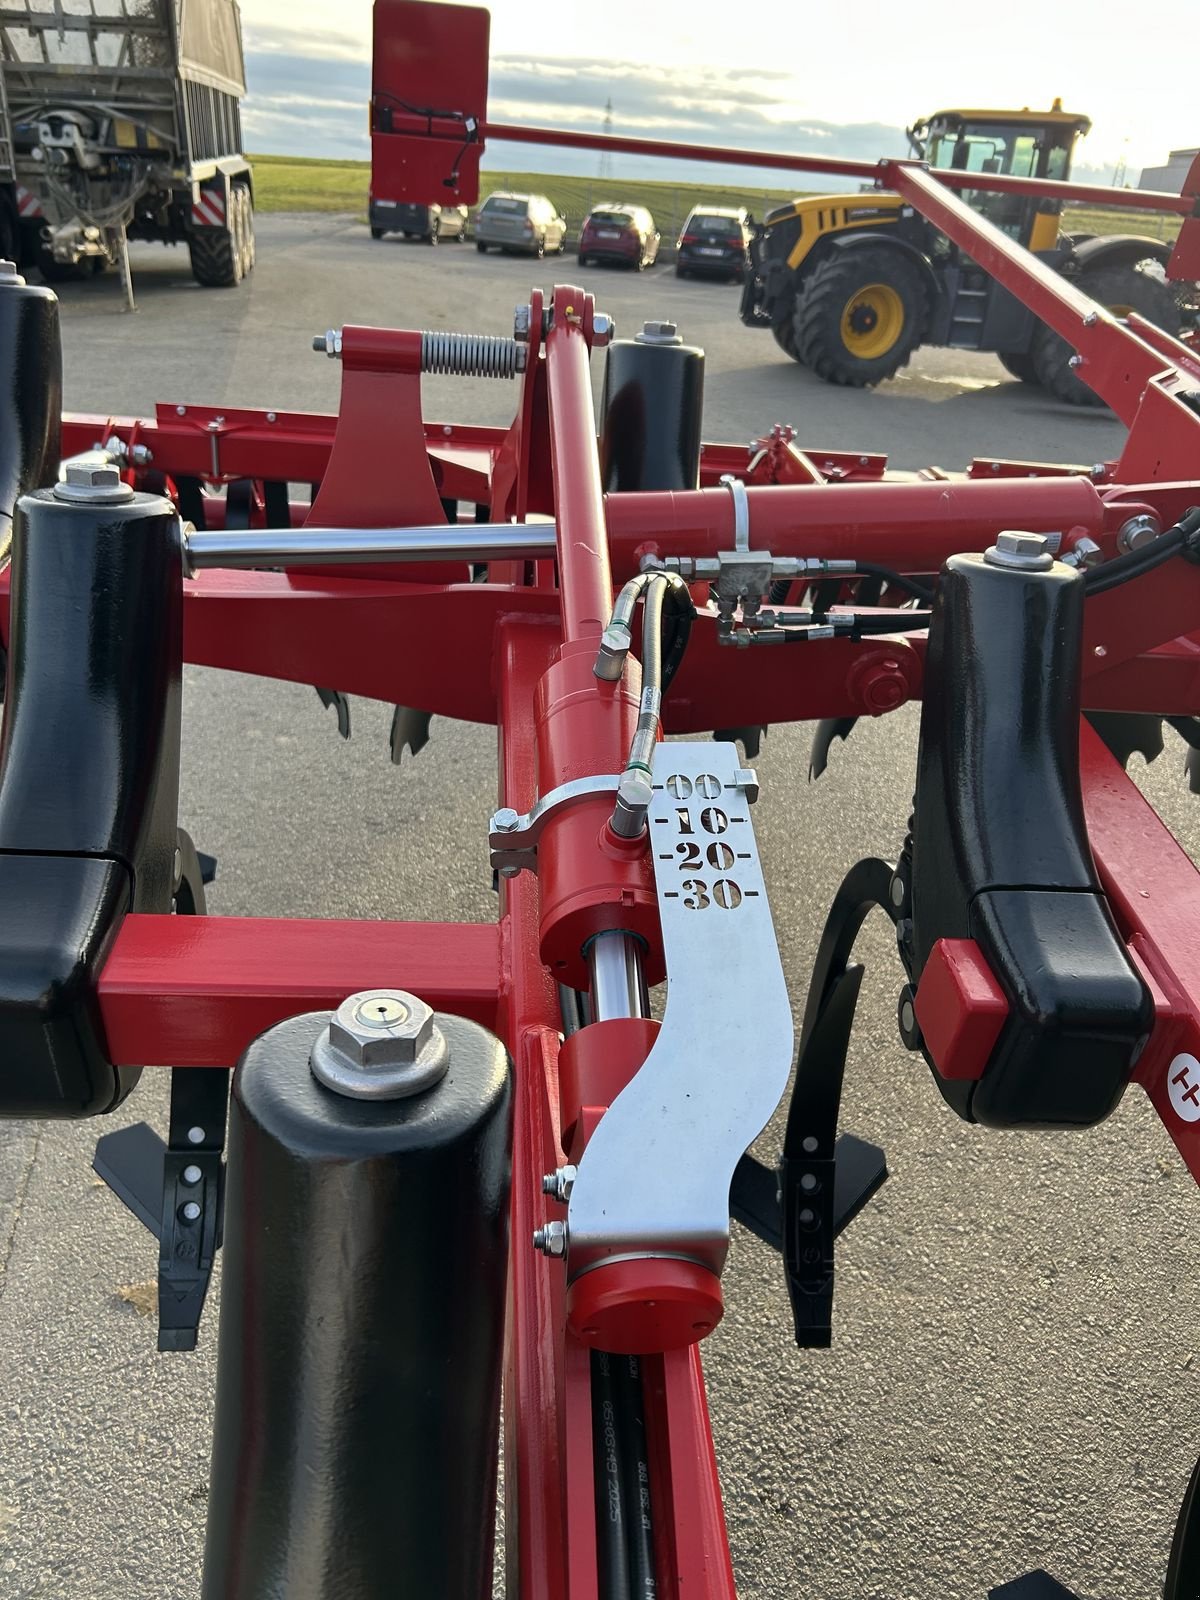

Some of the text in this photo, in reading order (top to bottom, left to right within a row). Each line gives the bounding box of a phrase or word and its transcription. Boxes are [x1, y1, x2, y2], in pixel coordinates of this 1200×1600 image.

[666, 774, 722, 800] 00
[675, 807, 728, 834] 10
[676, 842, 735, 871] 20
[682, 879, 742, 910] 30
[638, 1461, 648, 1482] BAR
[608, 1479, 621, 1522] 2025
